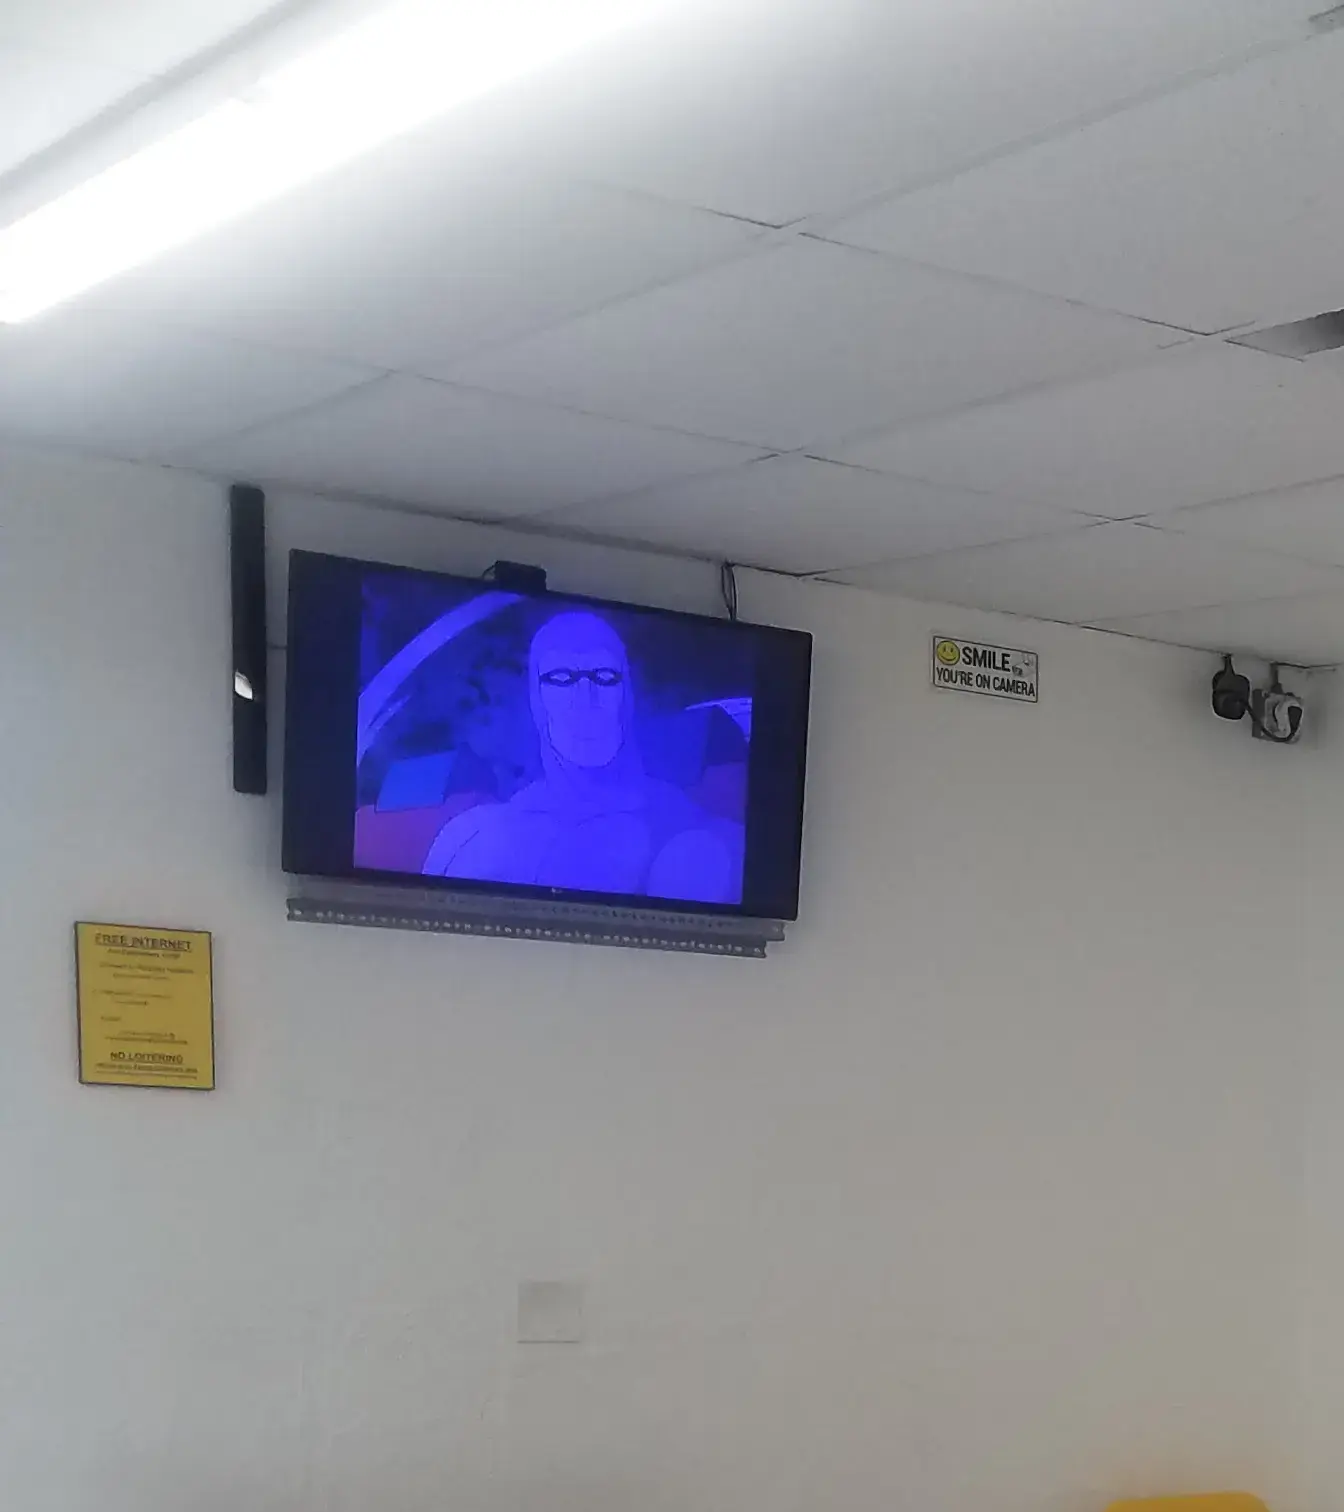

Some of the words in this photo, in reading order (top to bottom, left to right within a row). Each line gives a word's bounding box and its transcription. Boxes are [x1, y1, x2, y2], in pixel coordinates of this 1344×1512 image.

[962, 646, 1011, 672] SMILE
[936, 666, 973, 687] YOU'RE
[975, 673, 991, 690] ON
[993, 677, 1035, 697] CAMERA
[94, 932, 128, 945] FREE
[131, 936, 192, 951] INTERNET
[110, 1051, 126, 1062] NO
[128, 1052, 183, 1064] LOITERING
